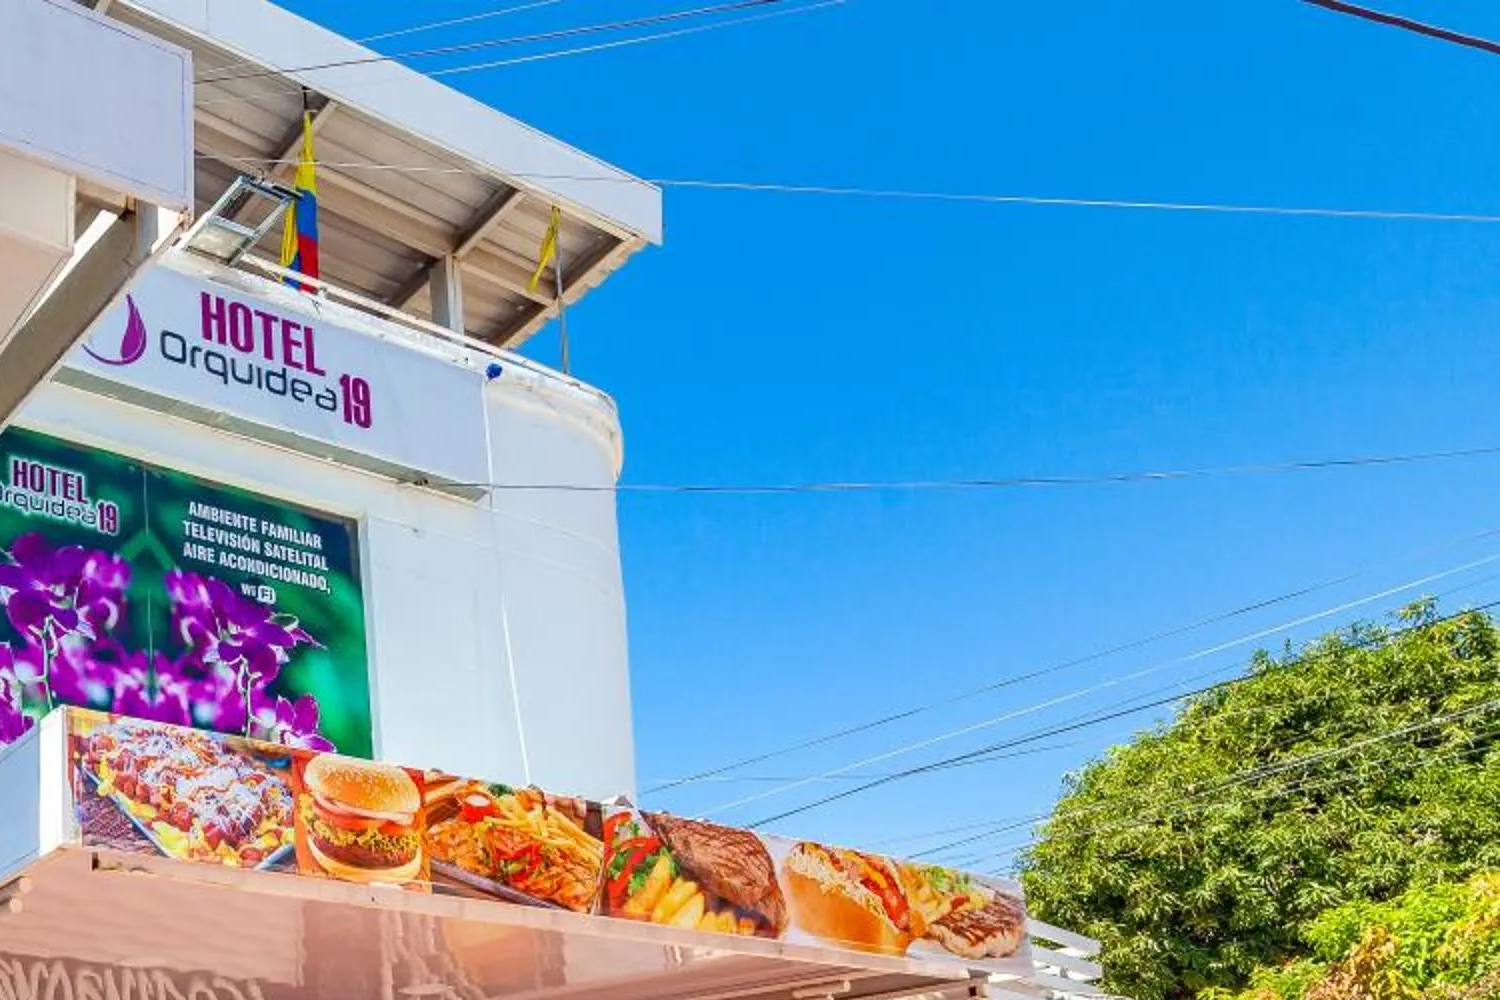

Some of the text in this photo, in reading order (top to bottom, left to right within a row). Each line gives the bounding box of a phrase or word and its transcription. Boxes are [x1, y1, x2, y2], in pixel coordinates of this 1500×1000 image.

[200, 291, 327, 377] HOTEL
[339, 373, 373, 430] 19
[12, 458, 89, 505] HOTEL
[98, 501, 118, 533] 19
[188, 501, 323, 550] AMBIENTE FAMILIAR
[182, 519, 329, 571] TELEVISIÓN SATELITAL
[183, 541, 215, 564] AIRE
